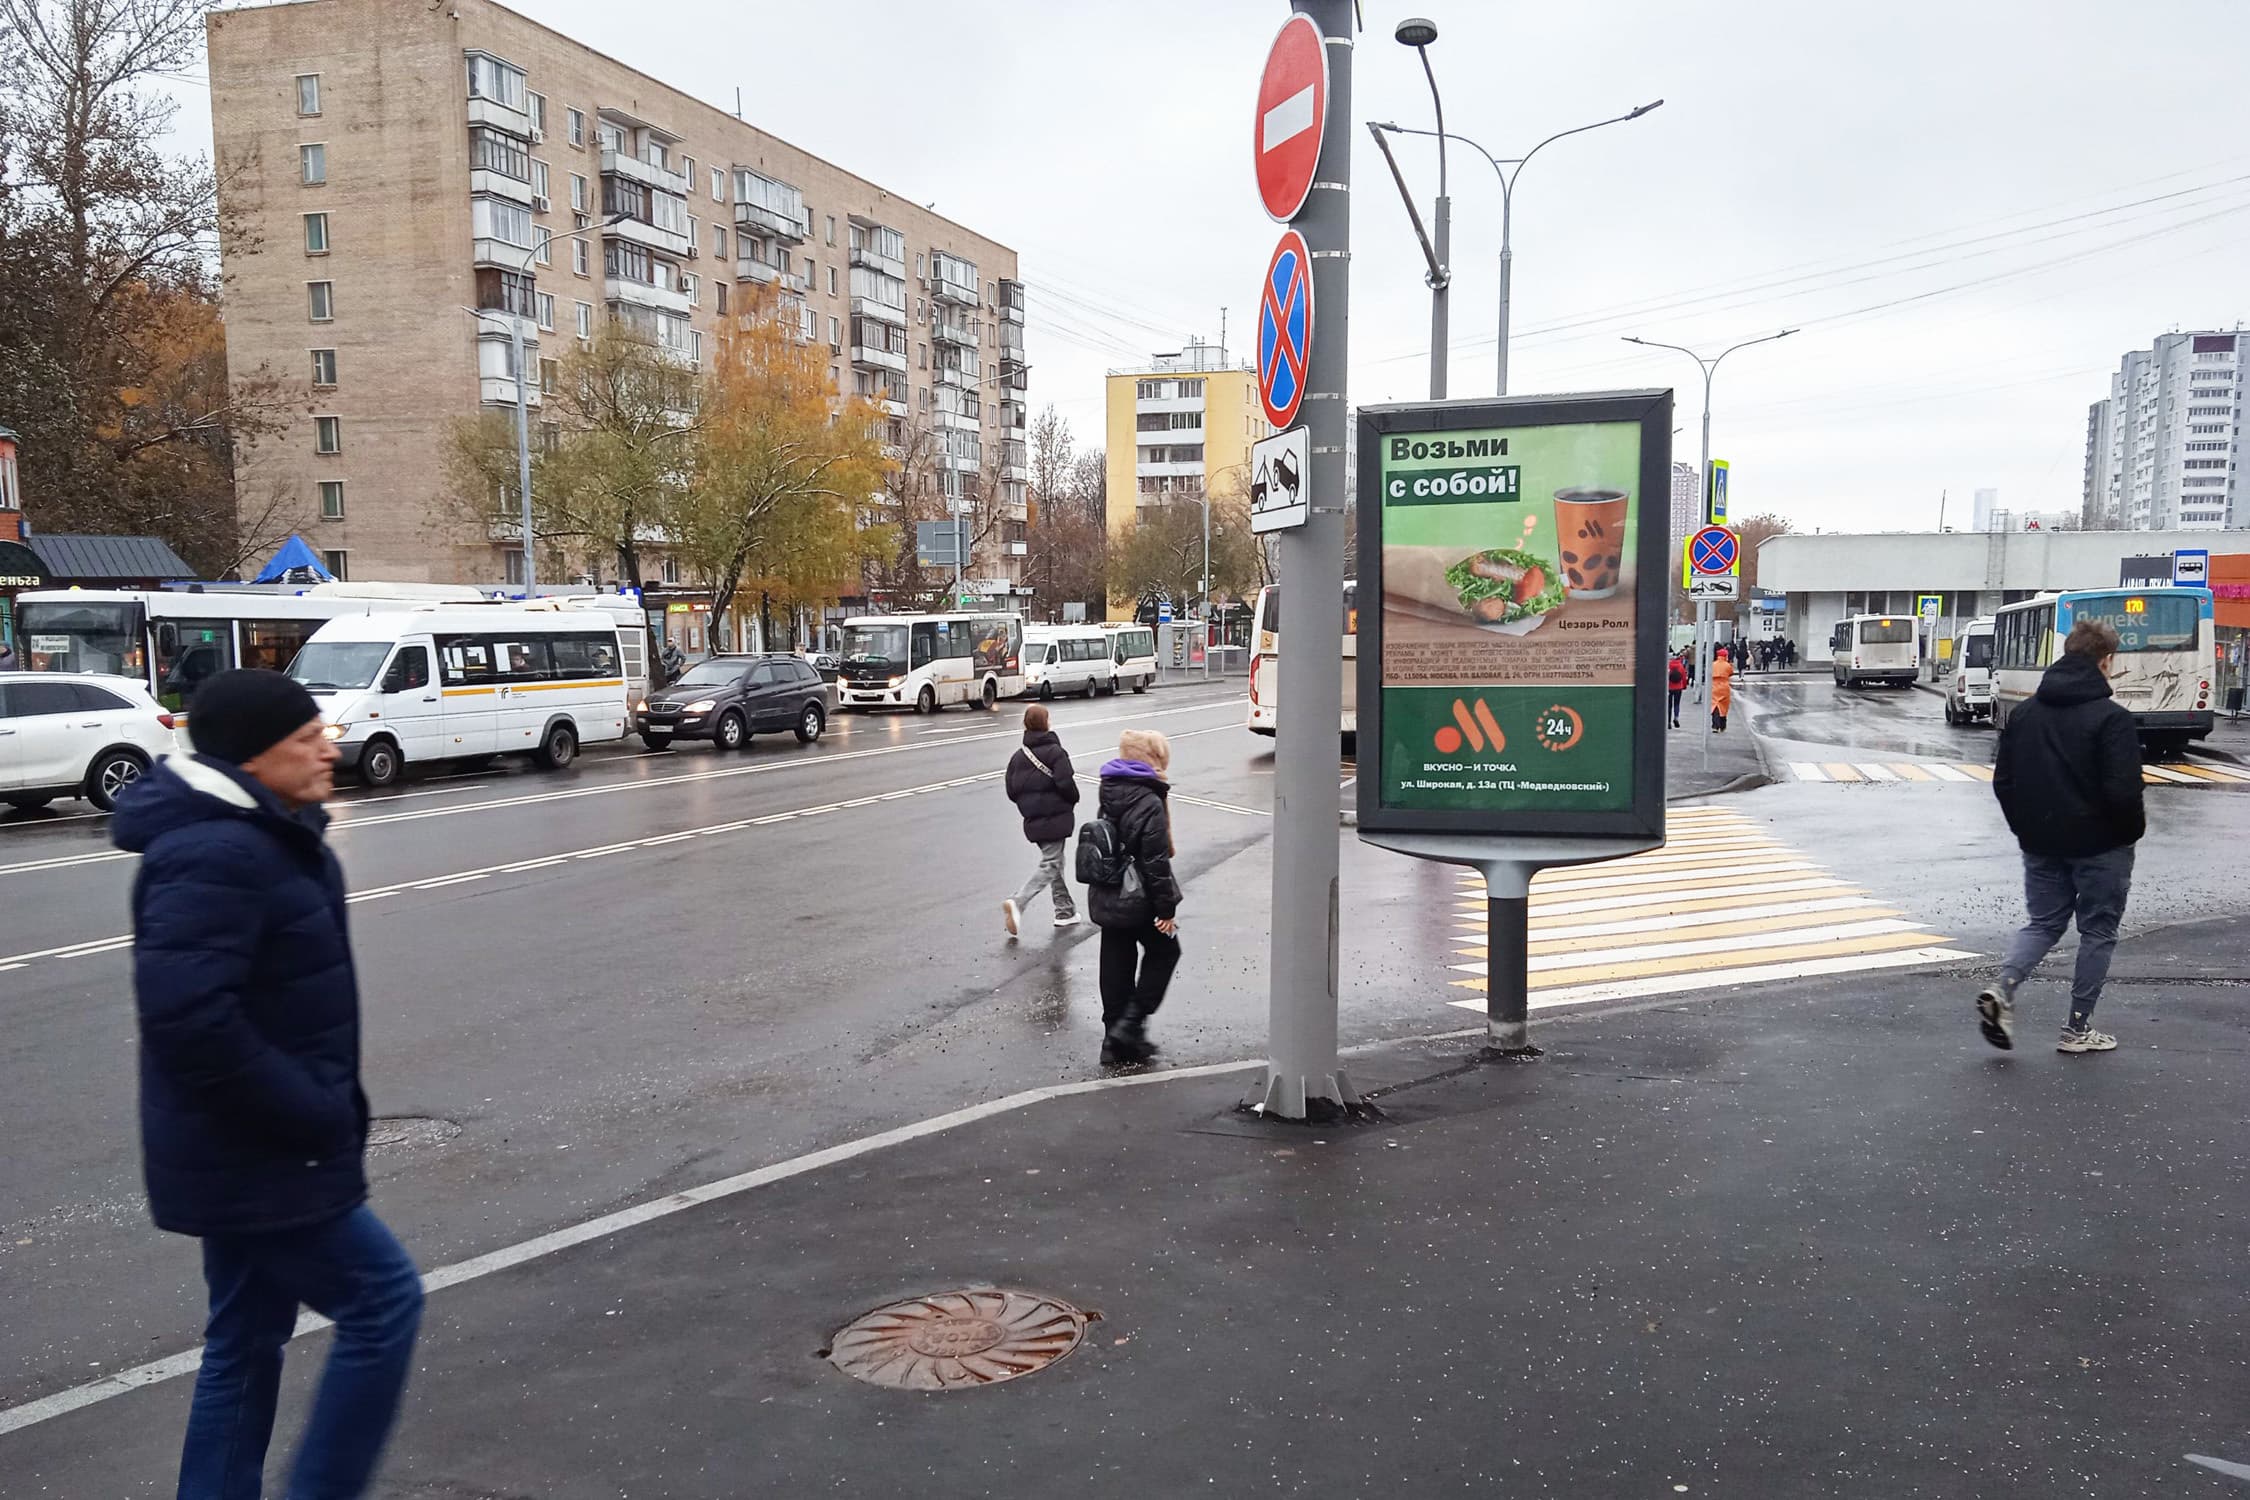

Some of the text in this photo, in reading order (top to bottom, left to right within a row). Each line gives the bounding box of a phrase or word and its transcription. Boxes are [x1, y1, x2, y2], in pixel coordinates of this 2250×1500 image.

[1391, 438, 1508, 461] Возьми
[1389, 468, 1517, 498] с собой!
[2125, 599, 2144, 613] 170
[1559, 619, 1629, 630] Цезарь Ролл
[1547, 718, 1572, 735] 24ч
[1483, 764, 1517, 772] ТОЧКА
[1401, 781, 1414, 790] ул.
[1417, 780, 1464, 790] Широкая,
[1466, 781, 1476, 790] д.
[1478, 780, 1497, 789] 13а
[1498, 780, 1515, 791] (ТЦ
